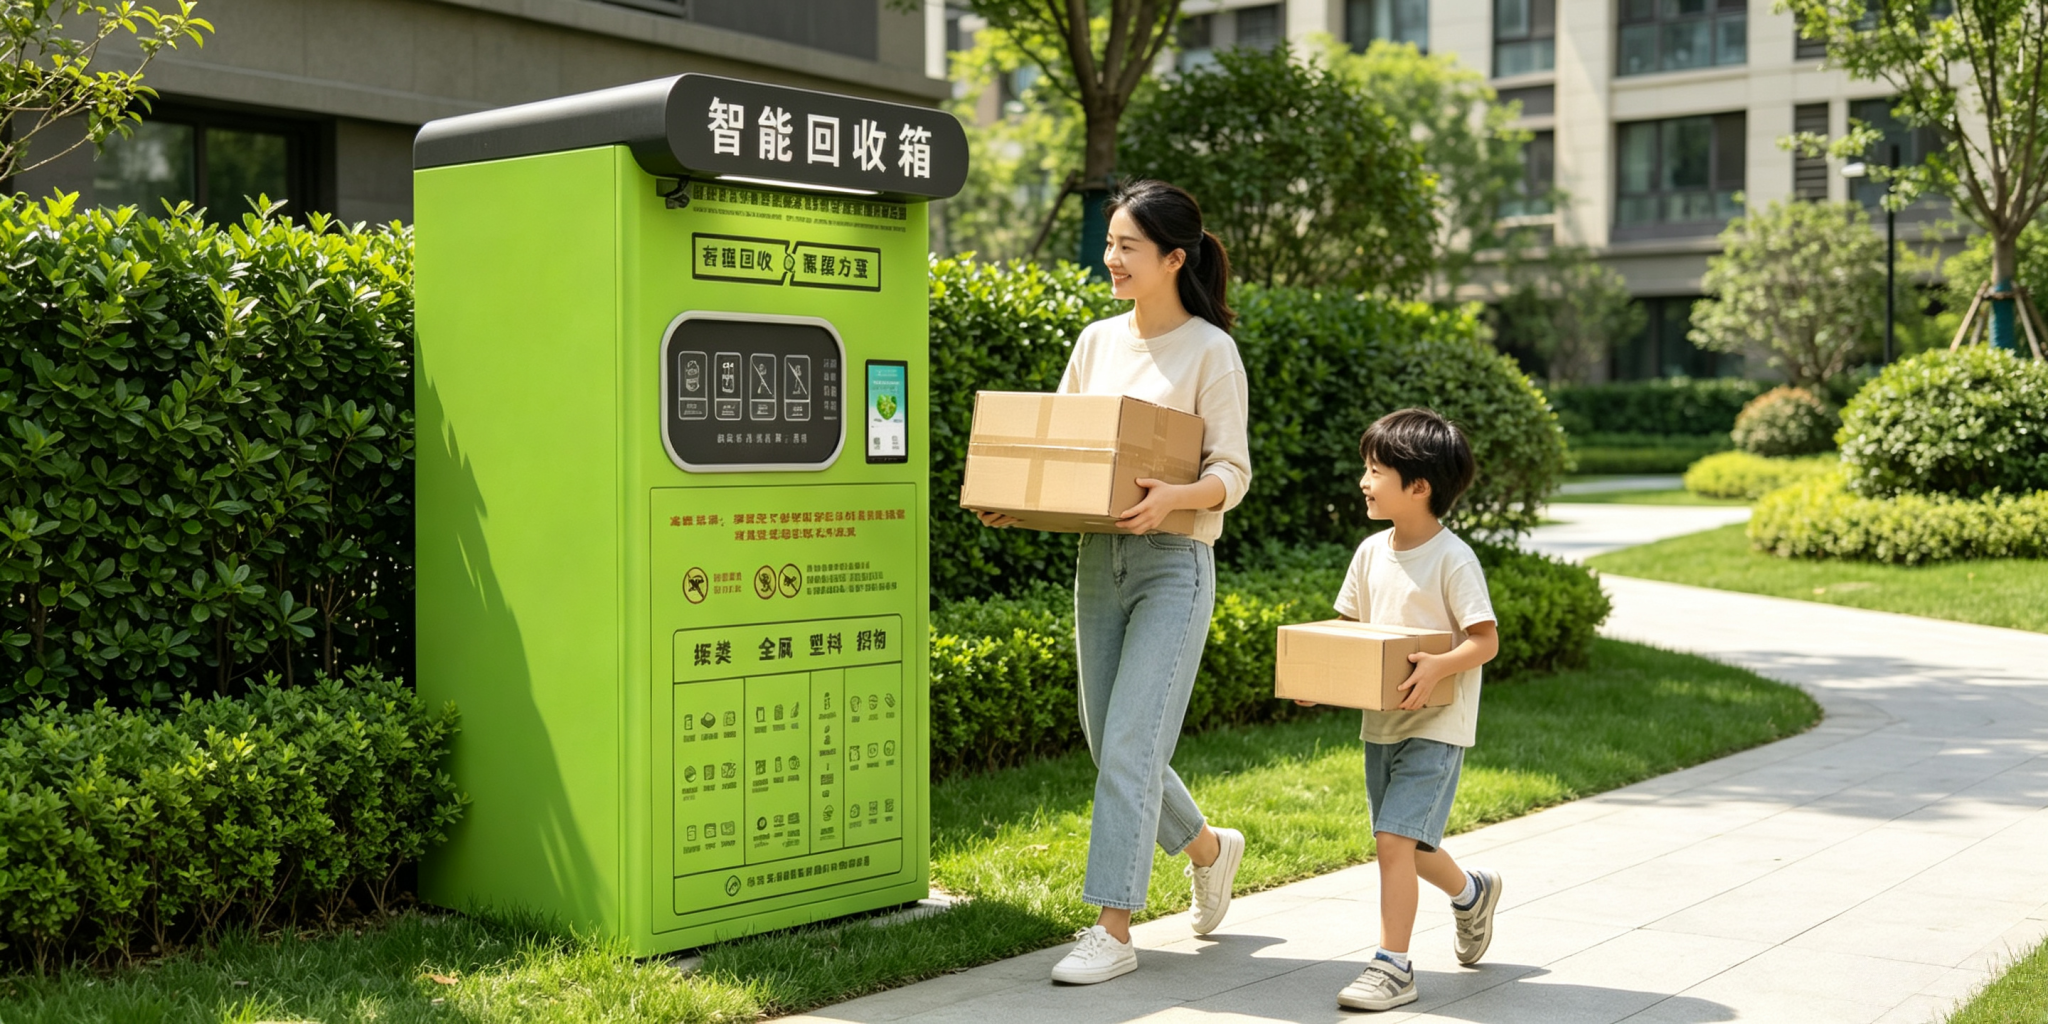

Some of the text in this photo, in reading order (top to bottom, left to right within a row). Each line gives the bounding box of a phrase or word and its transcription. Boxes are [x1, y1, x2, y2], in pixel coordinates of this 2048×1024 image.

[708, 96, 932, 179] 智能回收箱
